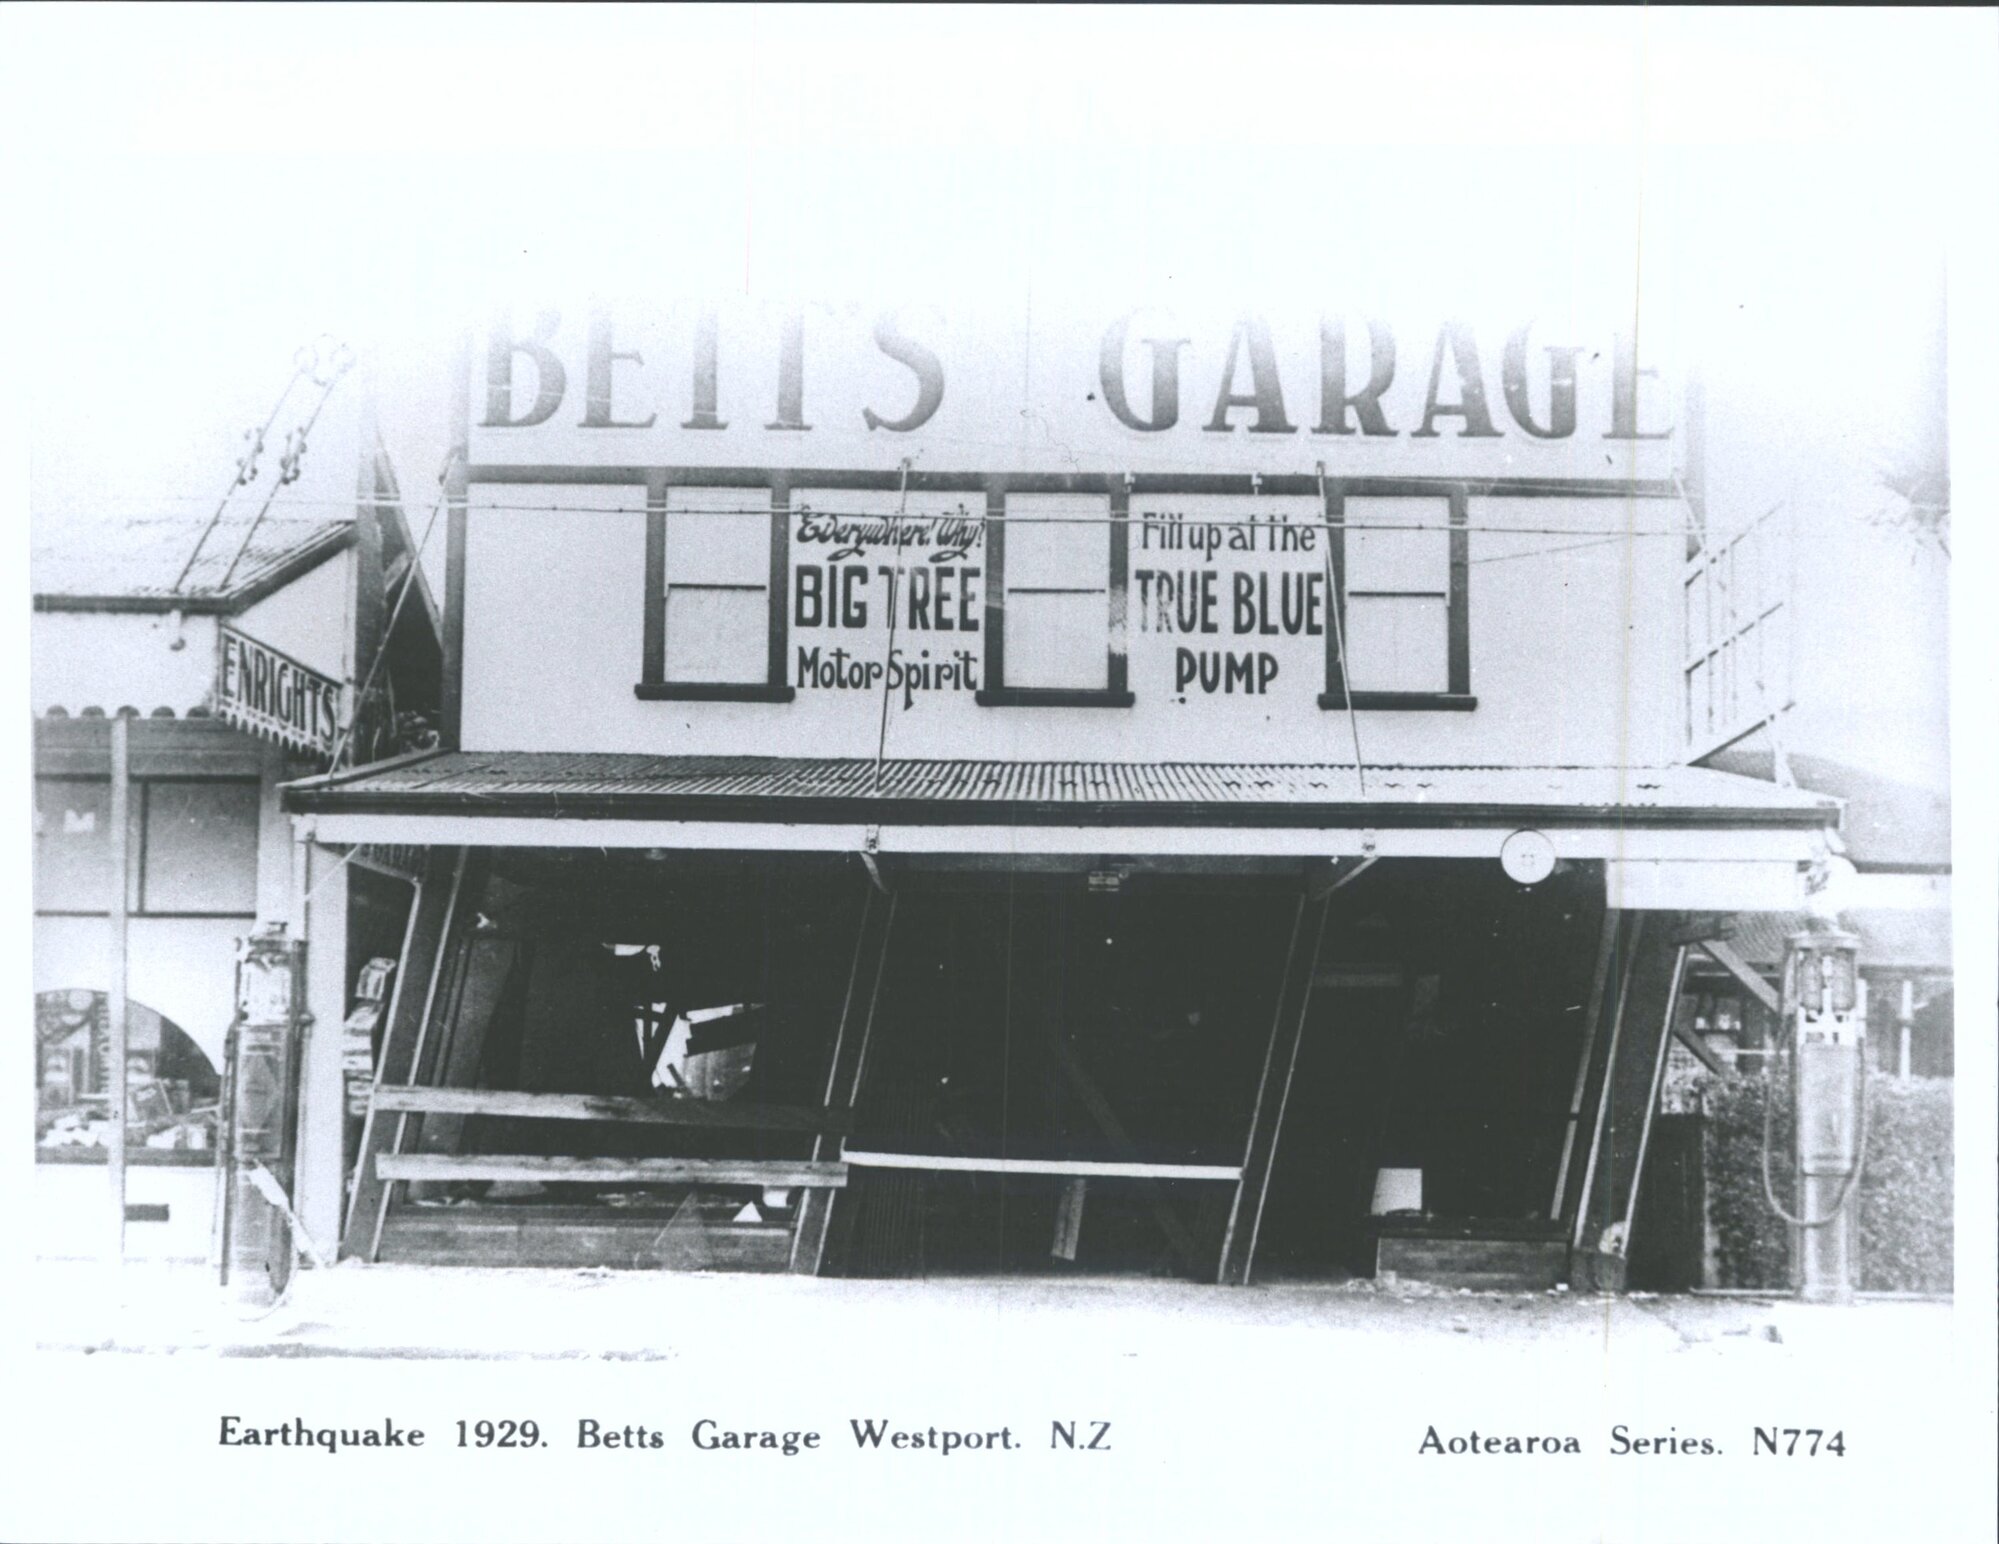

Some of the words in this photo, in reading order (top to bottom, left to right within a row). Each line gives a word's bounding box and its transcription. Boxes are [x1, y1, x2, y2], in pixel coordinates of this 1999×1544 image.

[1100, 307, 1673, 440] GARAGE
[1142, 512, 1183, 550] Fill
[1189, 523, 1221, 562] up
[1228, 514, 1256, 551] at
[1267, 514, 1316, 552] the
[794, 564, 869, 629] BIG
[878, 566, 981, 632] TREE
[1135, 569, 1219, 634] TRUE
[1233, 571, 1324, 636] BLUE
[222, 633, 336, 746] ENRIGHTS
[797, 646, 884, 690] Motor
[886, 649, 978, 711] Spirit
[1176, 646, 1279, 695] PUMP
